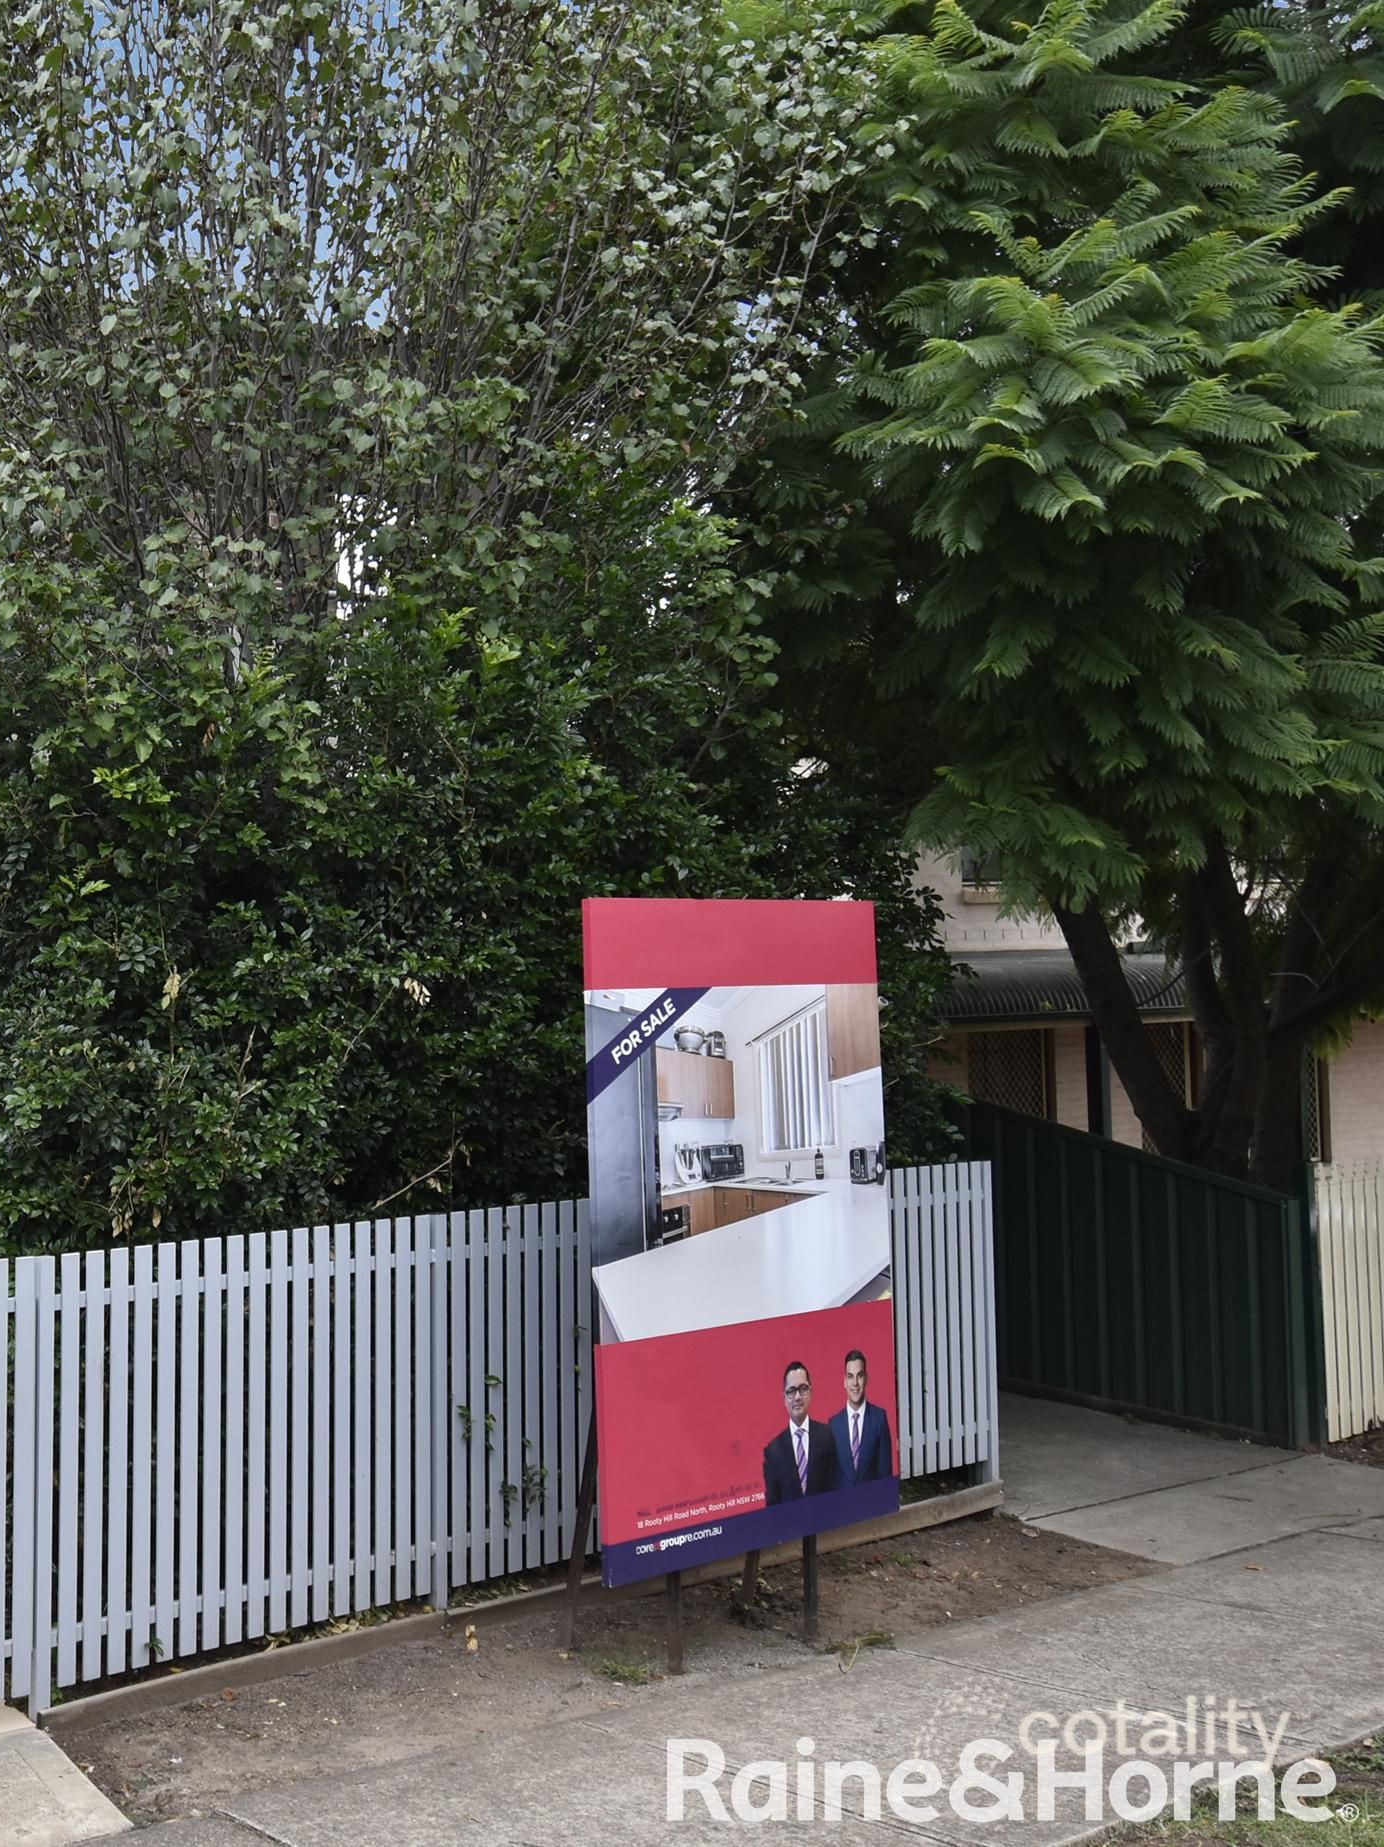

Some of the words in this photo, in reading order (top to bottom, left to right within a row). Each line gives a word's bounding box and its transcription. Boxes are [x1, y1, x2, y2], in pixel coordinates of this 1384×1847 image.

[611, 1030, 643, 1065] FOR
[641, 997, 677, 1037] SALE
[644, 1517, 663, 1528] Rooty
[663, 1513, 673, 1523] Hill
[673, 1509, 689, 1520] Road
[708, 1502, 726, 1512] Rooty
[726, 1498, 735, 1508] Hill
[736, 1495, 750, 1505] NSW
